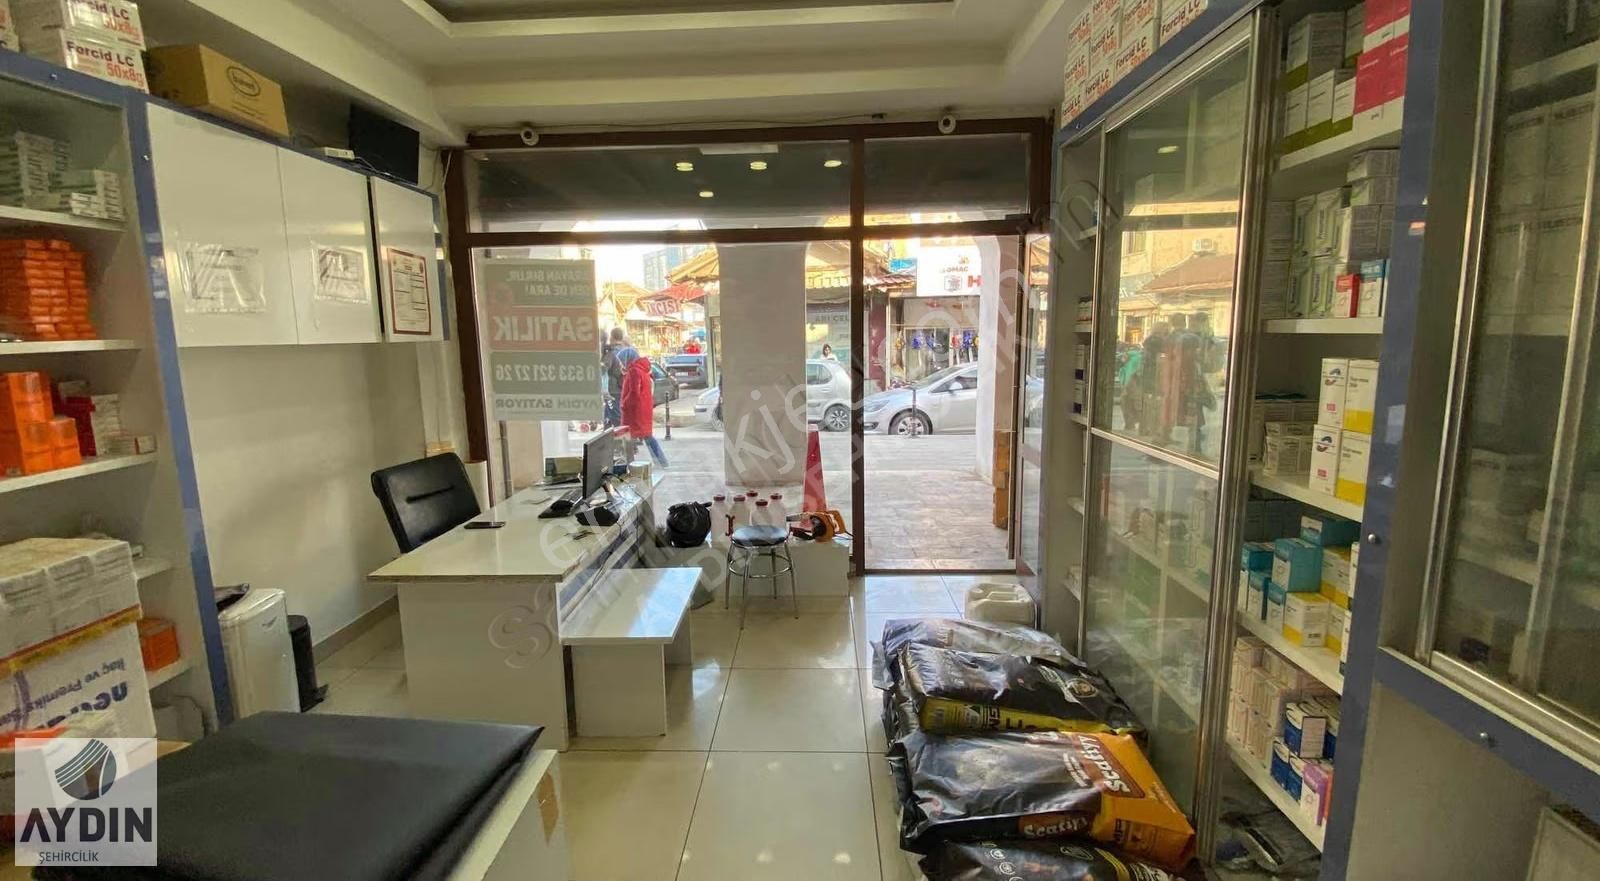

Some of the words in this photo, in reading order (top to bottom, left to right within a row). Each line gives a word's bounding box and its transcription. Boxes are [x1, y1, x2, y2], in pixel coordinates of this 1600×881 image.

[112, 6, 129, 20] LC
[1162, 11, 1186, 36] Forcid
[66, 41, 112, 62] Forcid
[116, 51, 134, 67] LC
[106, 63, 145, 87] 50x8g
[85, 671, 100, 683] ve
